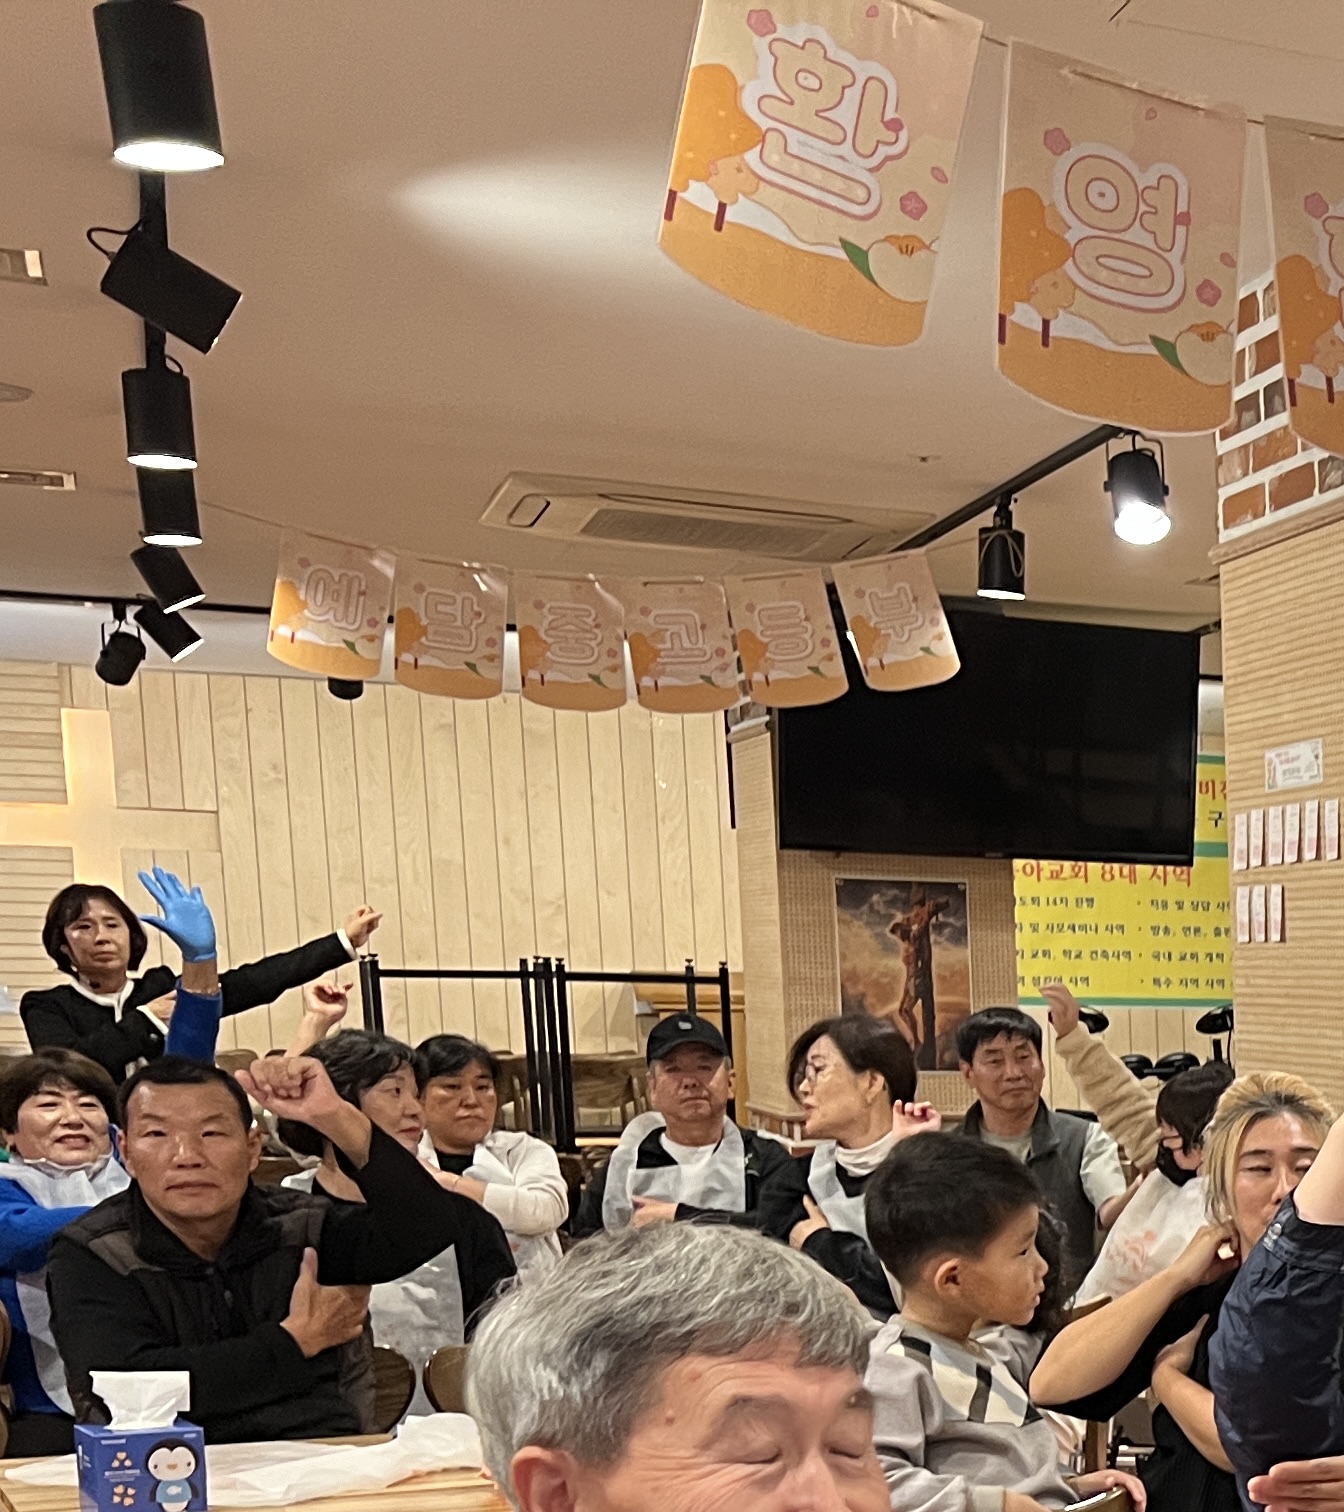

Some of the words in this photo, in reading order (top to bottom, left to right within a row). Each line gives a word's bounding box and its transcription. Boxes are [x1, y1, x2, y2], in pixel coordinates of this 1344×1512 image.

[1015, 861, 1089, 884] 아교회
[1100, 864, 1138, 885] 8대
[1149, 866, 1193, 888] 사역
[1029, 922, 1040, 934] 및
[1104, 923, 1125, 936] 사역
[1030, 949, 1056, 961] 교회,
[1062, 949, 1083, 961] 학교
[1151, 951, 1173, 963] 국내
[1178, 951, 1199, 964] 교회
[1069, 975, 1090, 987] 사역
[1205, 977, 1225, 990] 사역
